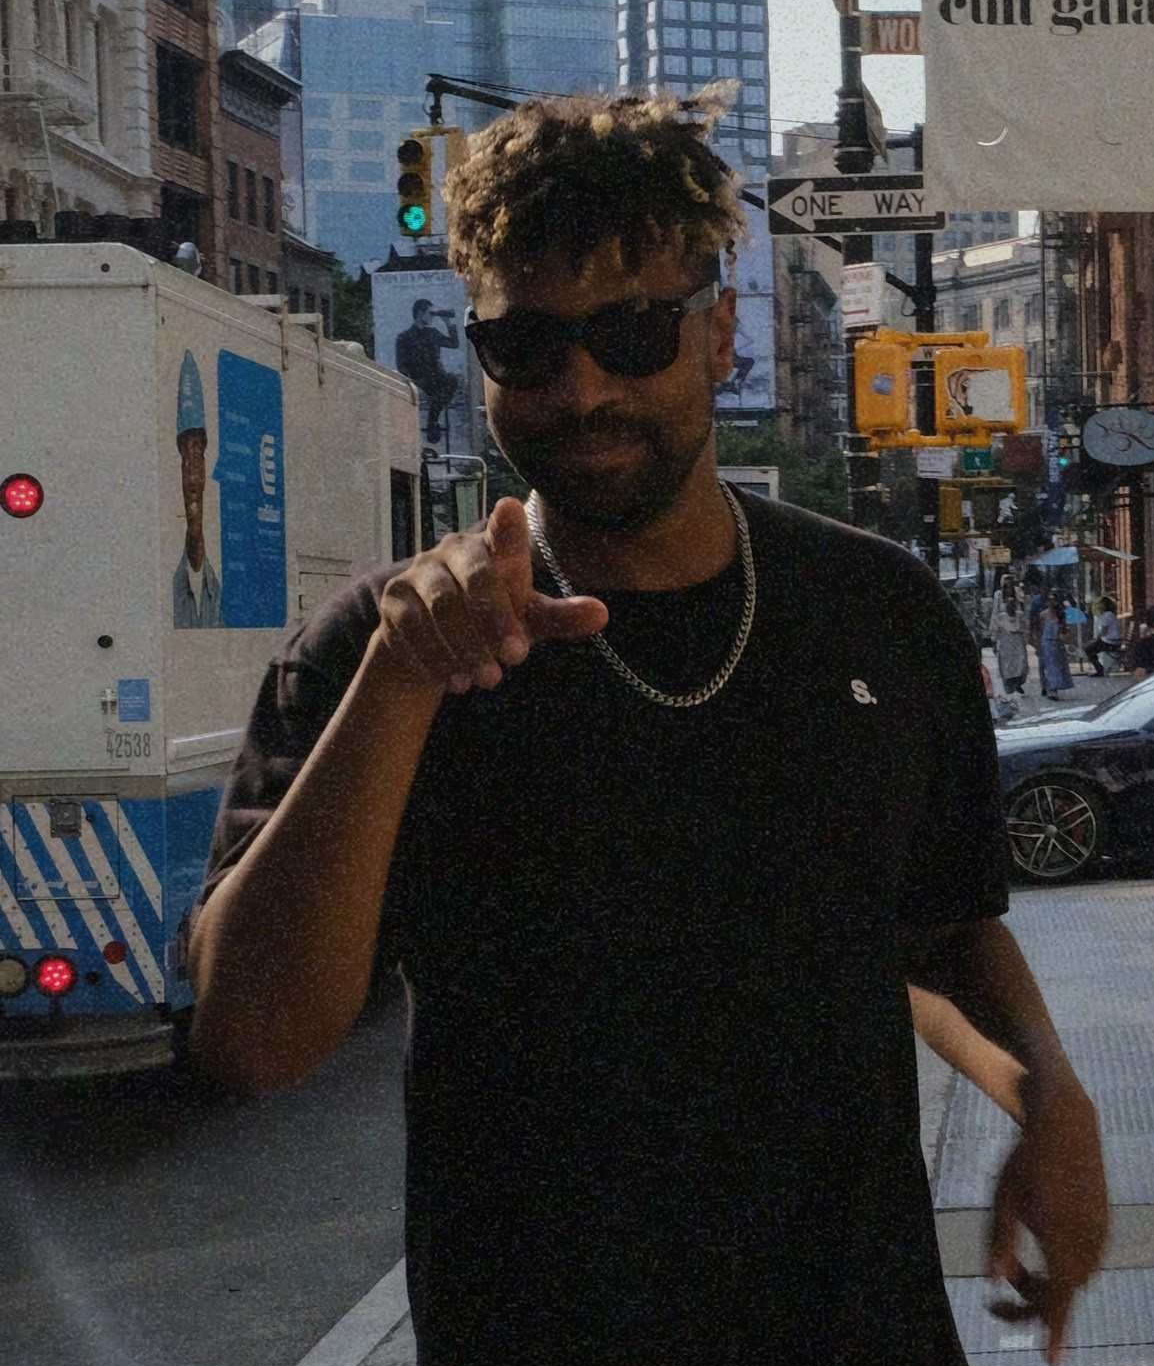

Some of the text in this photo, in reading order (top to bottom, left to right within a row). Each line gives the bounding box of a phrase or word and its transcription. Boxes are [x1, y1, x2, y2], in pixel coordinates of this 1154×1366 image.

[791, 192, 925, 217] ONE WAY
[106, 732, 151, 759] 42538
